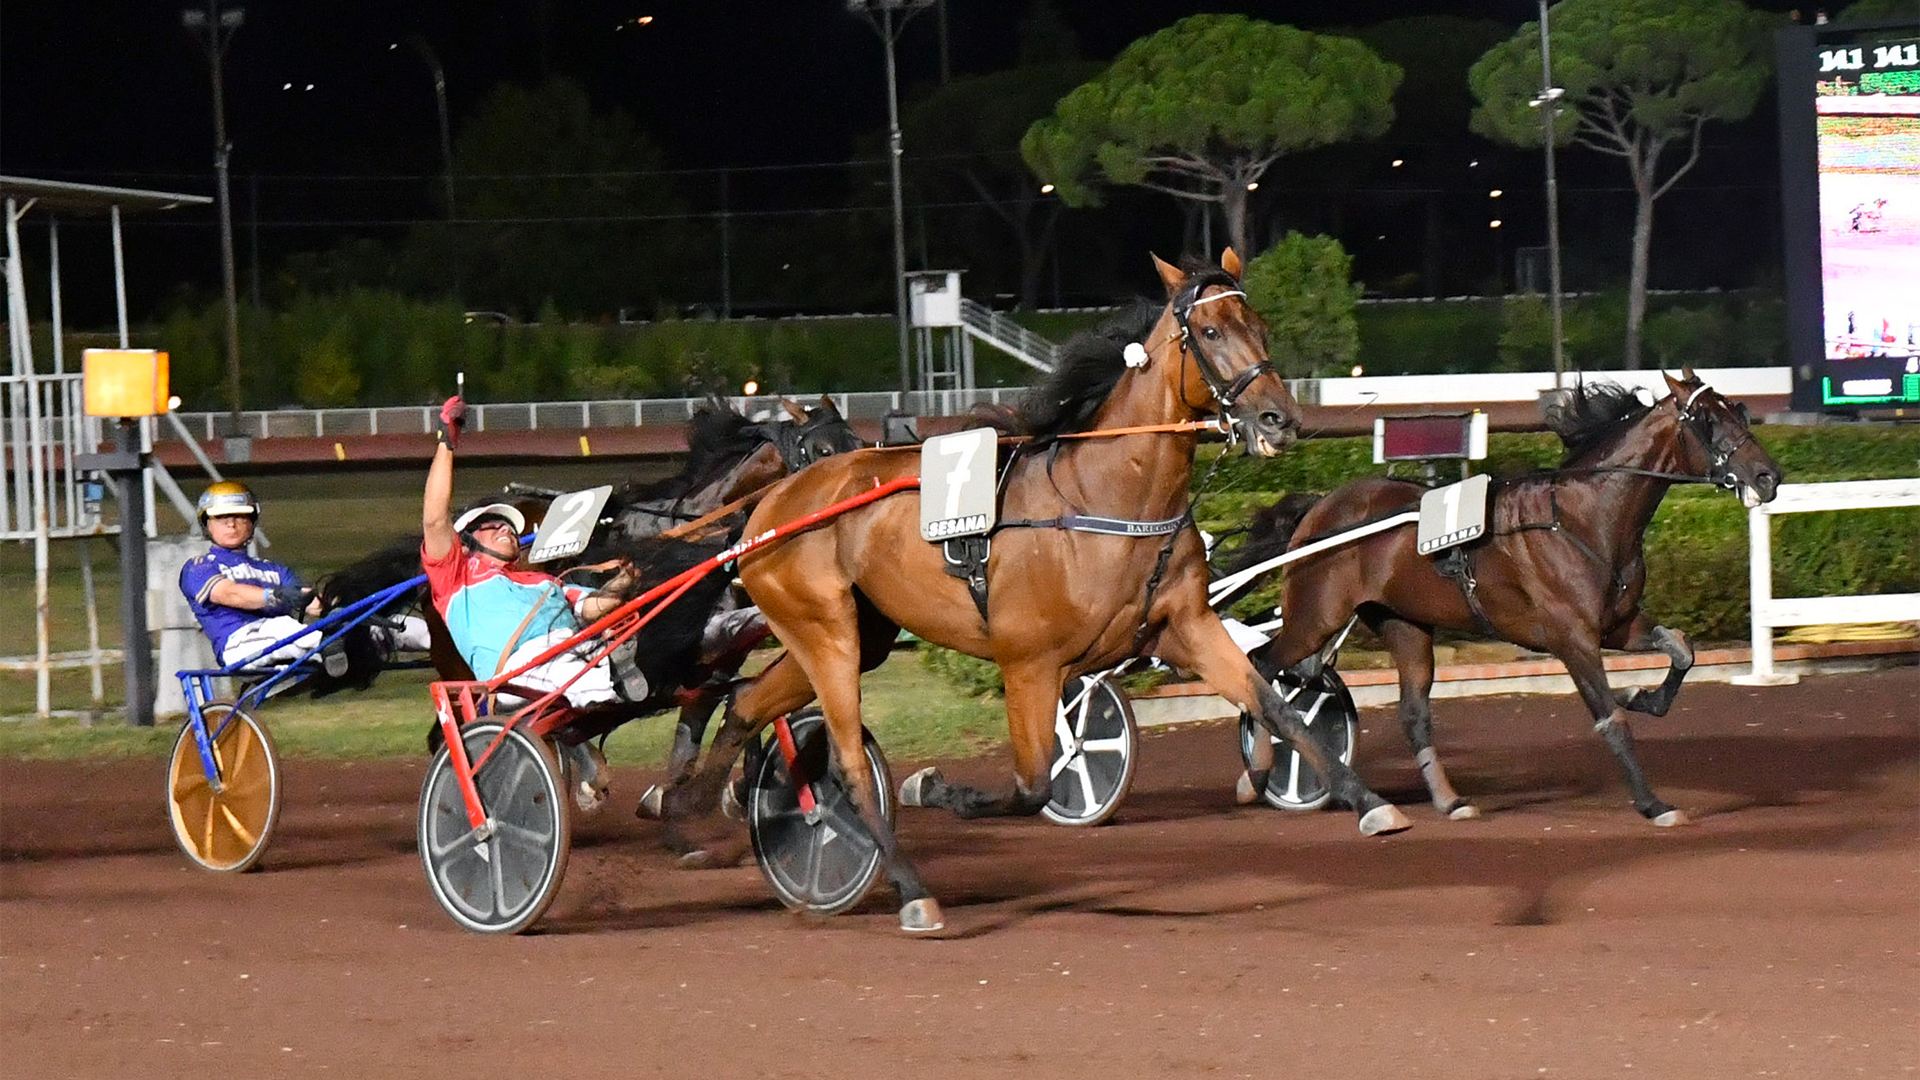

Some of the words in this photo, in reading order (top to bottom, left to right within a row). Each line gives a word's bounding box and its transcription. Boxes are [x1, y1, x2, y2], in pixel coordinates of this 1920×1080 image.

[940, 432, 981, 517] 7
[544, 490, 595, 548] 2
[928, 515, 986, 537] SESANA
[1443, 483, 1462, 535] 1
[534, 541, 580, 559] SESANA
[1421, 526, 1478, 551] SESANA
